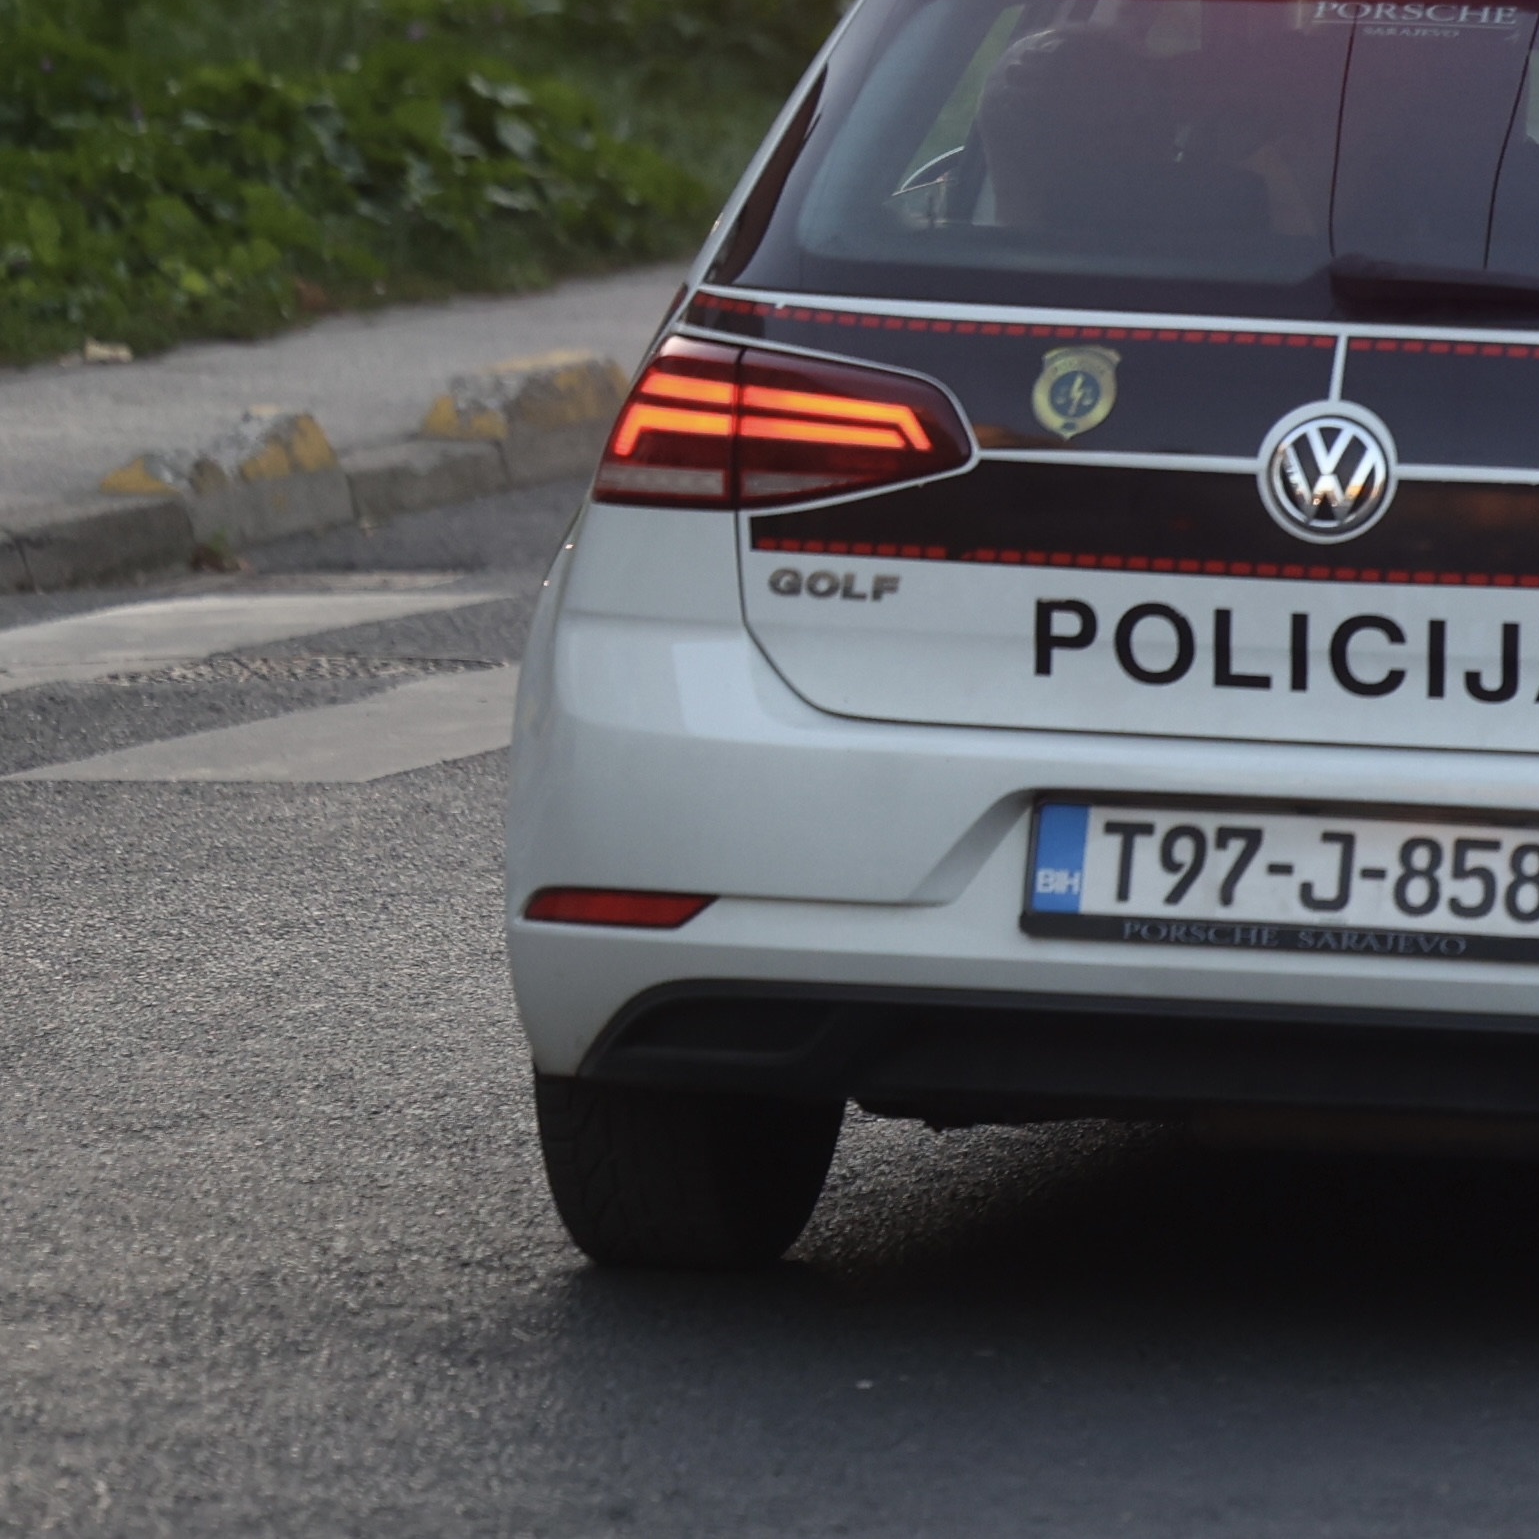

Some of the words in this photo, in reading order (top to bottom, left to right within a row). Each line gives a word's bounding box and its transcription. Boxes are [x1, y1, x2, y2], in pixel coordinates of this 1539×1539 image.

[1313, 0, 1518, 25] PORSCHE
[769, 568, 901, 603] GOLF
[1035, 867, 1082, 895] BIH
[1122, 919, 1280, 948] PORSCHE
[1298, 927, 1468, 957] SARAJEVO
